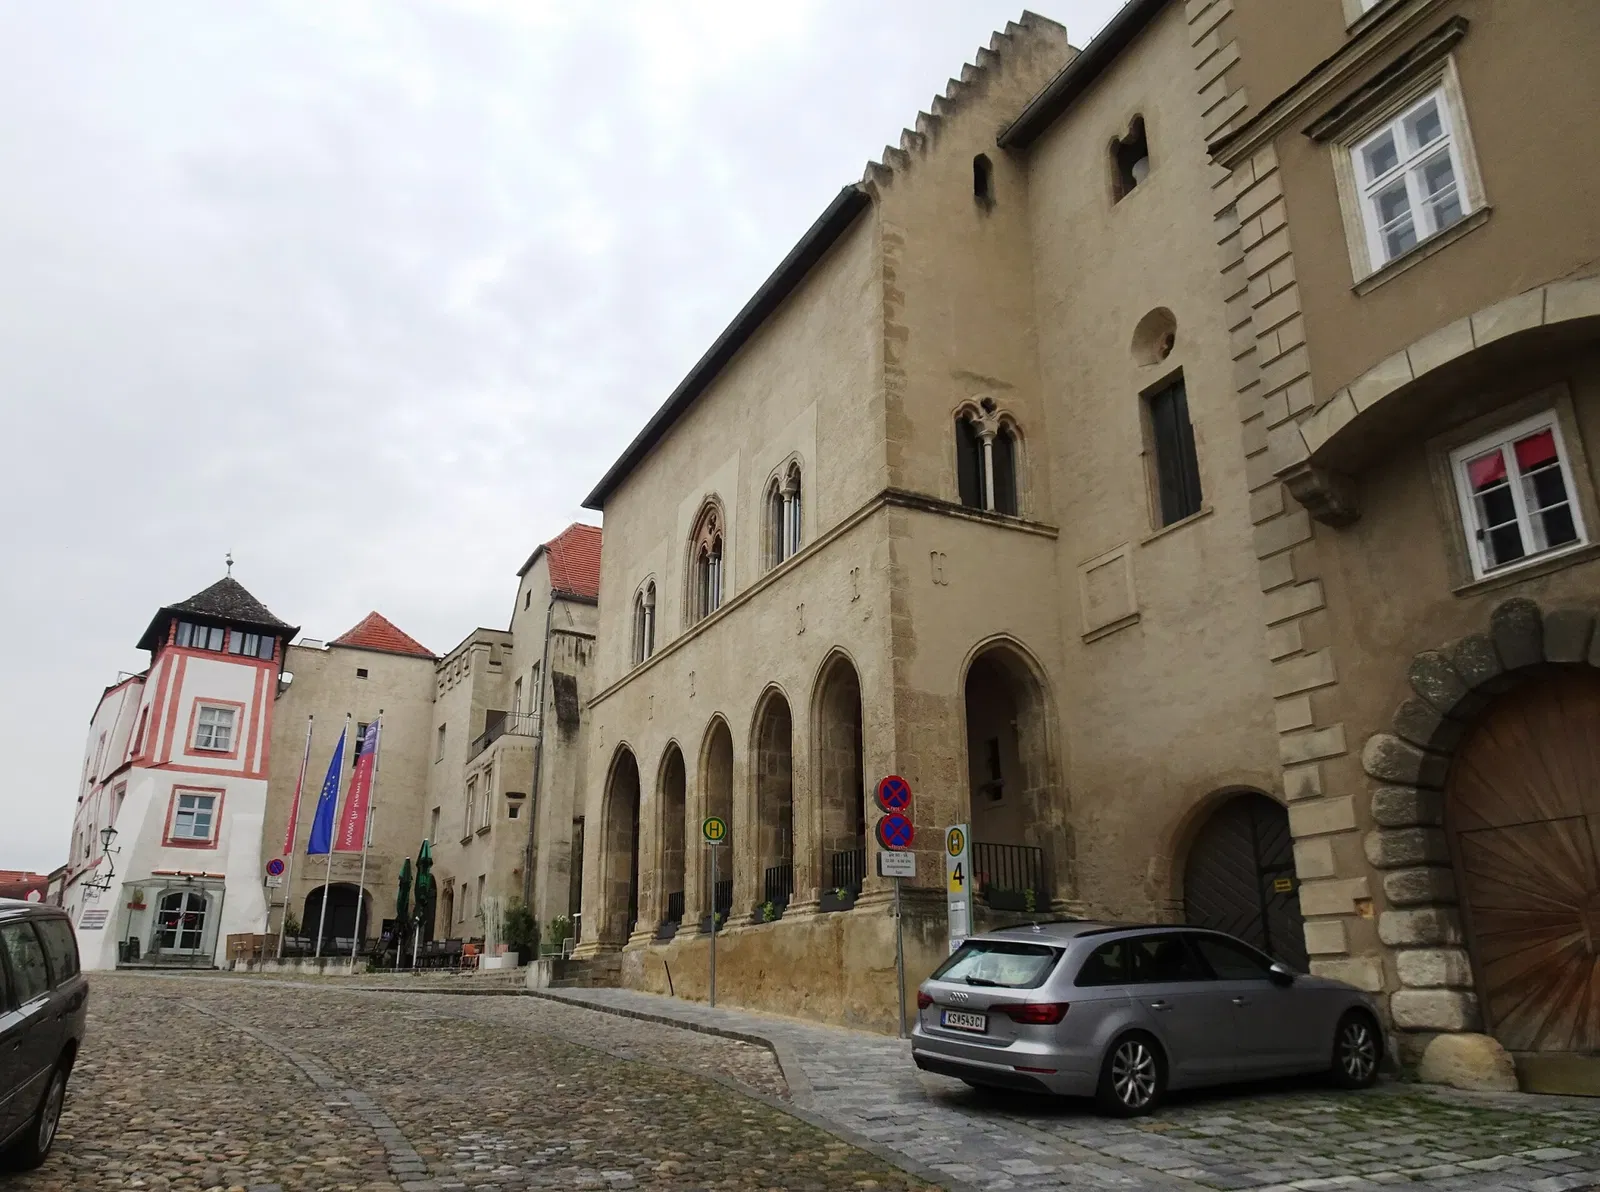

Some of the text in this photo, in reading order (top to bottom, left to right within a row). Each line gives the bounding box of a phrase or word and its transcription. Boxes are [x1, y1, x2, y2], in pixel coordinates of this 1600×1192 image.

[709, 822, 719, 836] H
[951, 833, 960, 850] H
[952, 862, 965, 886] 4
[948, 1013, 957, 1024] KS
